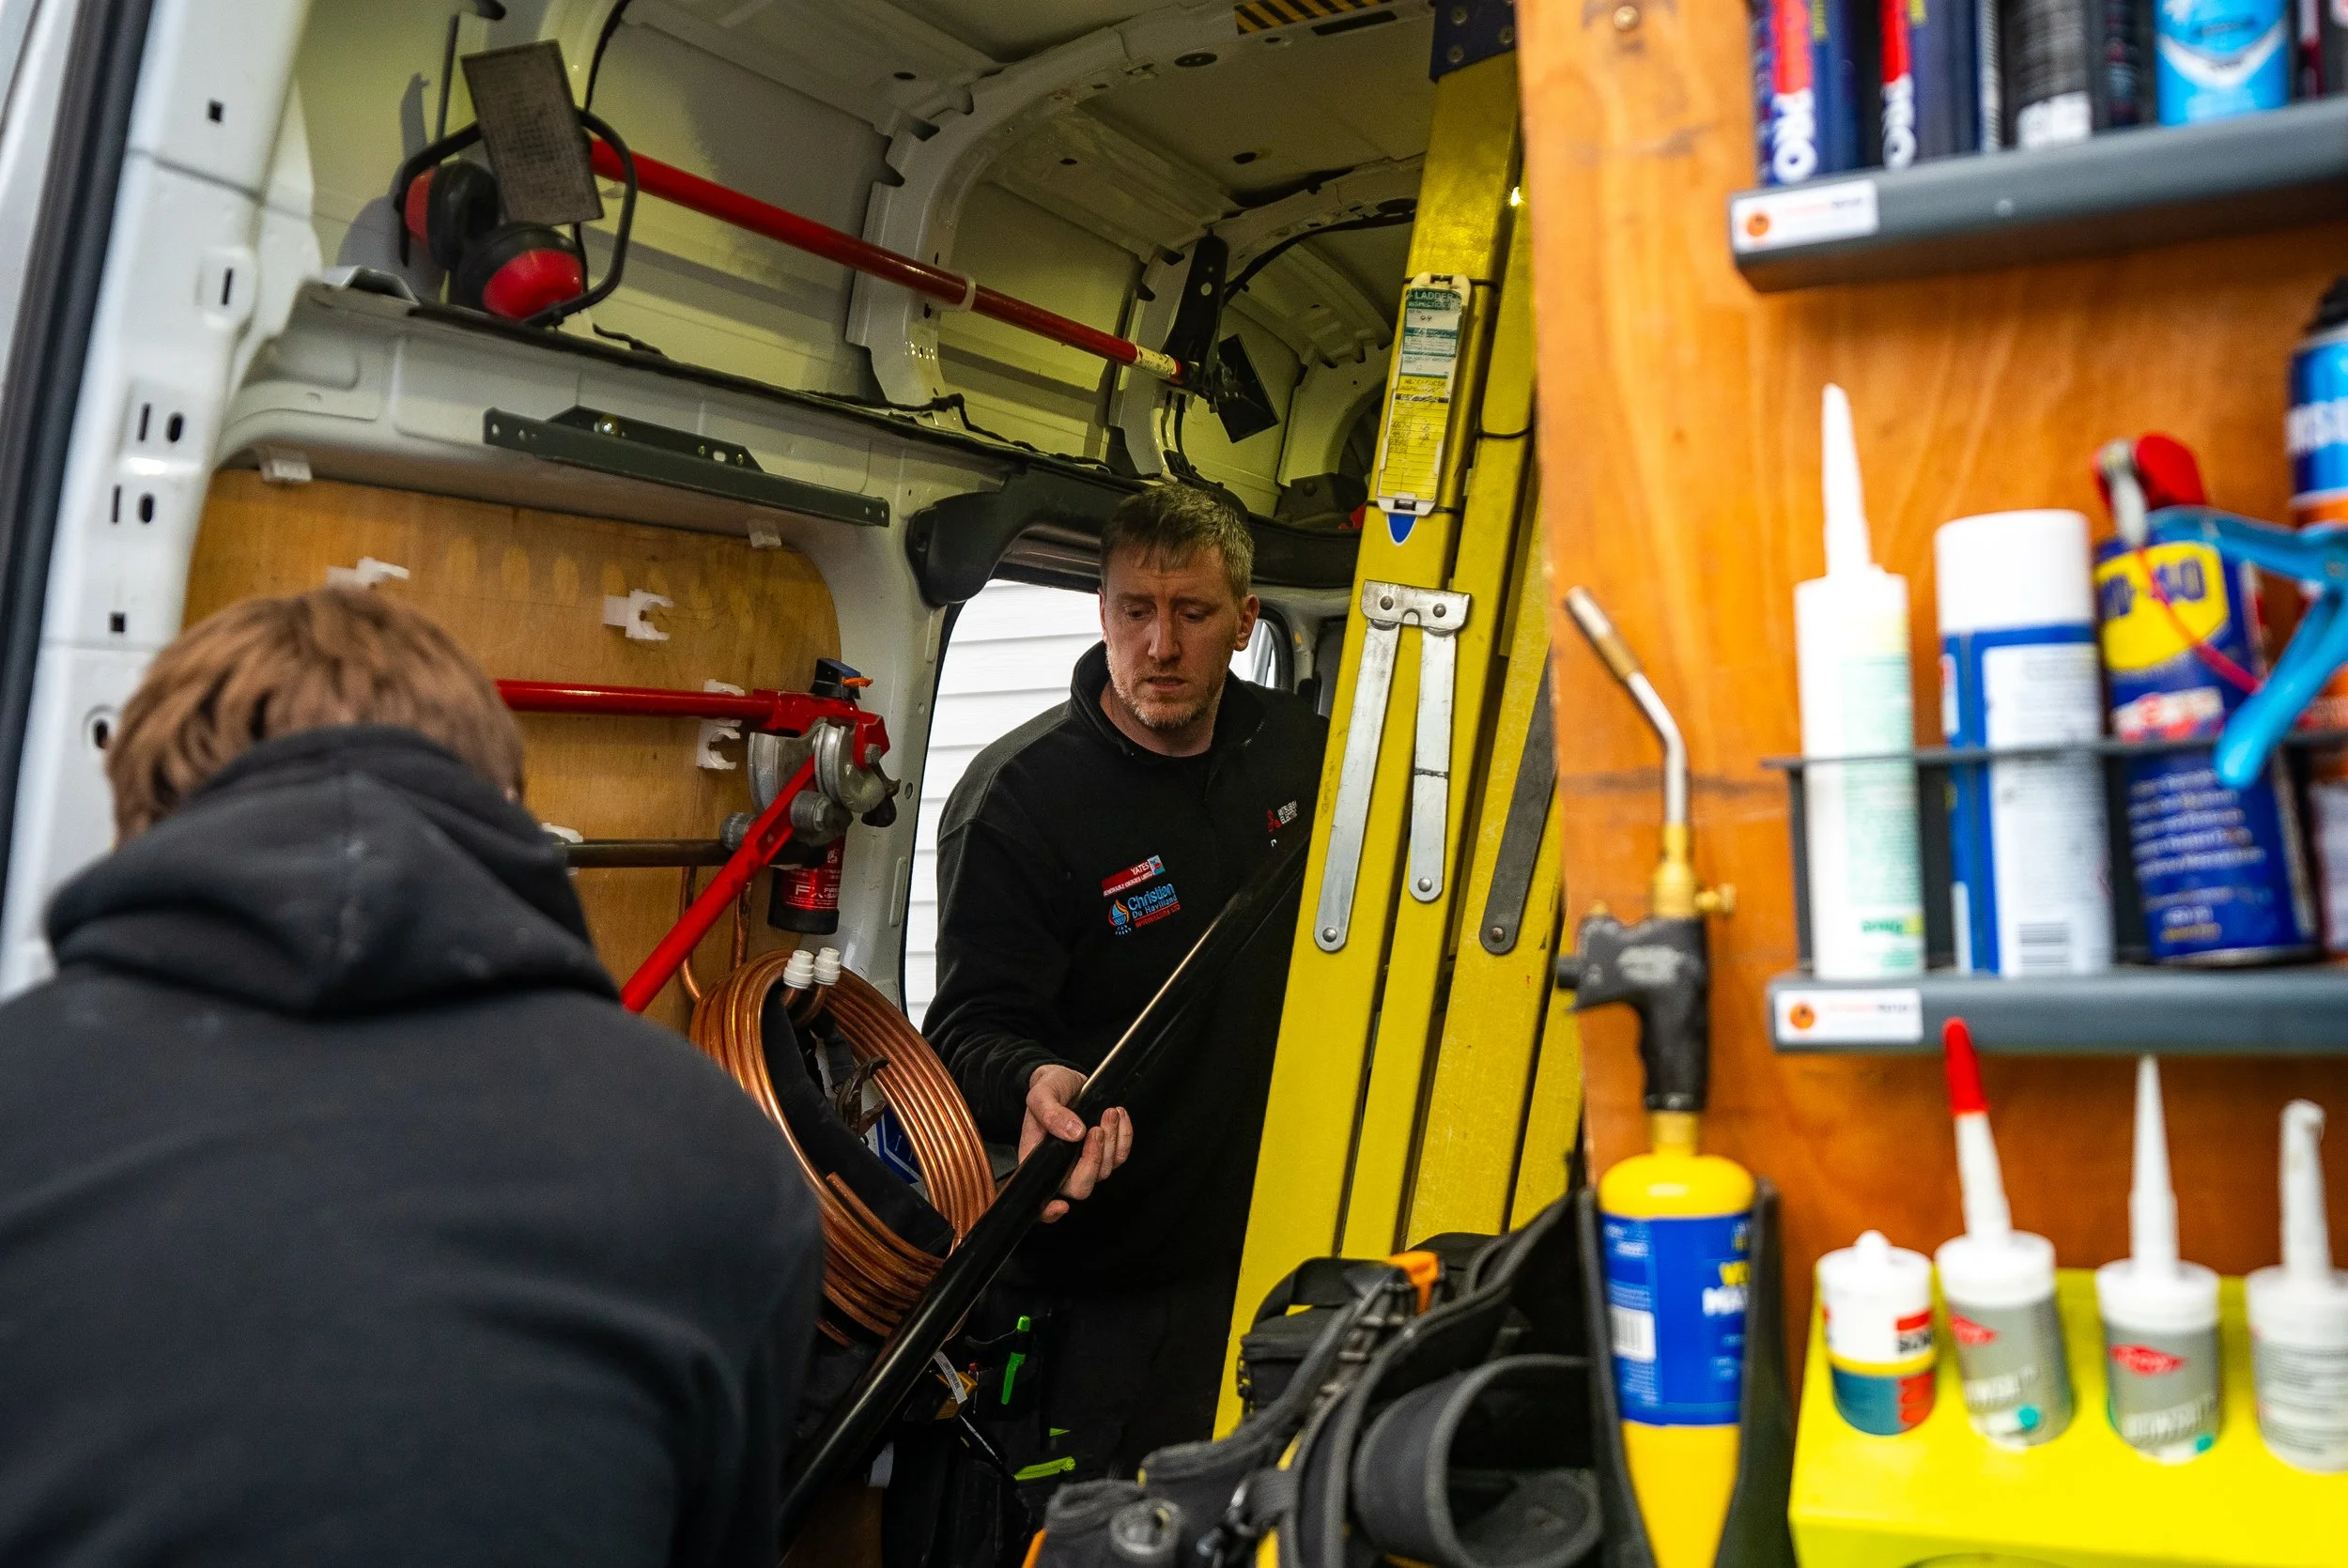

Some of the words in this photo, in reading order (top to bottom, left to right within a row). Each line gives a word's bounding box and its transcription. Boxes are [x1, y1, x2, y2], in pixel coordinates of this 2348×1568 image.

[1414, 291, 1453, 301] LADDER
[1130, 861, 1151, 876] YATES
[1127, 883, 1176, 911] Christian
[1144, 894, 1178, 915] Havilland
